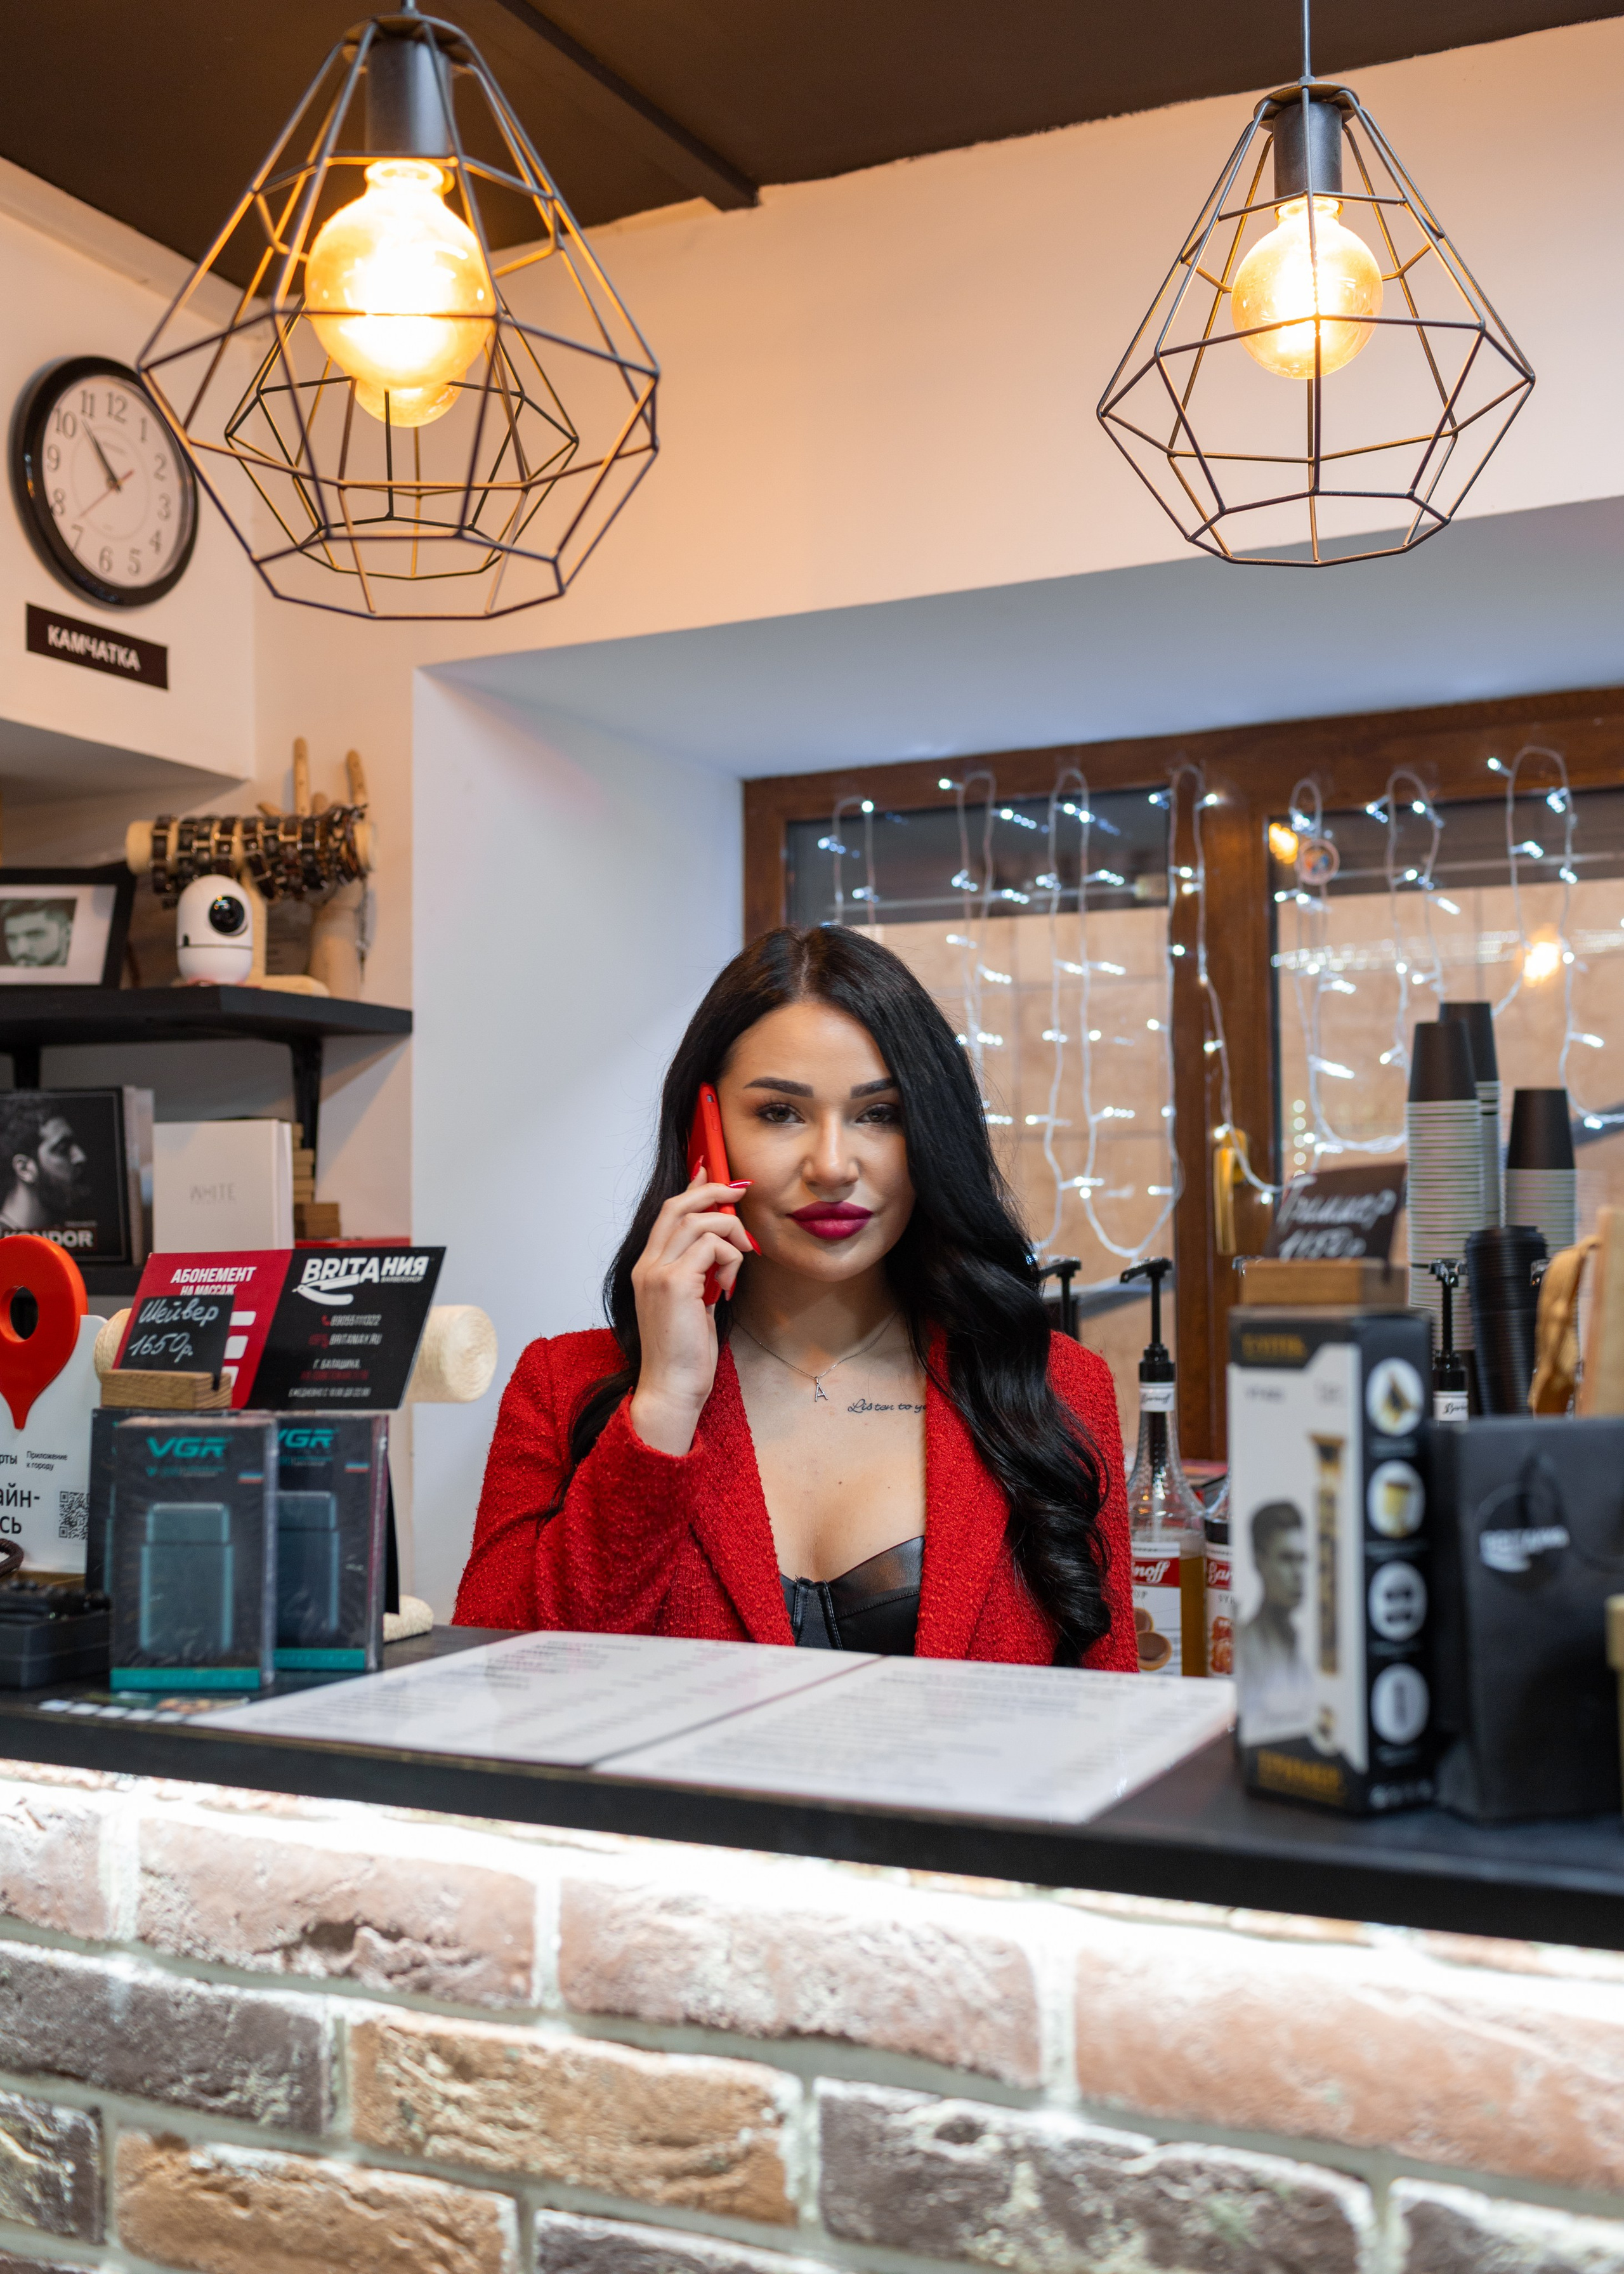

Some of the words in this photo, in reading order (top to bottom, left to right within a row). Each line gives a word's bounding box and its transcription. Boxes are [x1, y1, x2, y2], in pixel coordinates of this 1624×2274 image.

[81, 389, 95, 419] 11
[107, 391, 128, 424] 12
[55, 407, 77, 438] 10
[140, 417, 147, 443] 1
[47, 444, 61, 472] 9
[154, 452, 167, 482] 2
[51, 487, 66, 516] 8
[71, 523, 84, 553] 7
[99, 546, 113, 573] 6
[48, 624, 141, 672] КАМЧАТКА
[170, 1266, 257, 1284] АБОНЕМЕНТ
[180, 1285, 193, 1296] НА
[194, 1284, 237, 1296] МАССАЖ
[138, 1298, 219, 1327] Шейвер
[848, 1398, 894, 1413] Listen
[914, 1403, 927, 1413] yo
[27, 1451, 68, 1461] Приложение
[147, 1436, 226, 1458] VGR
[32, 1462, 54, 1471] городу
